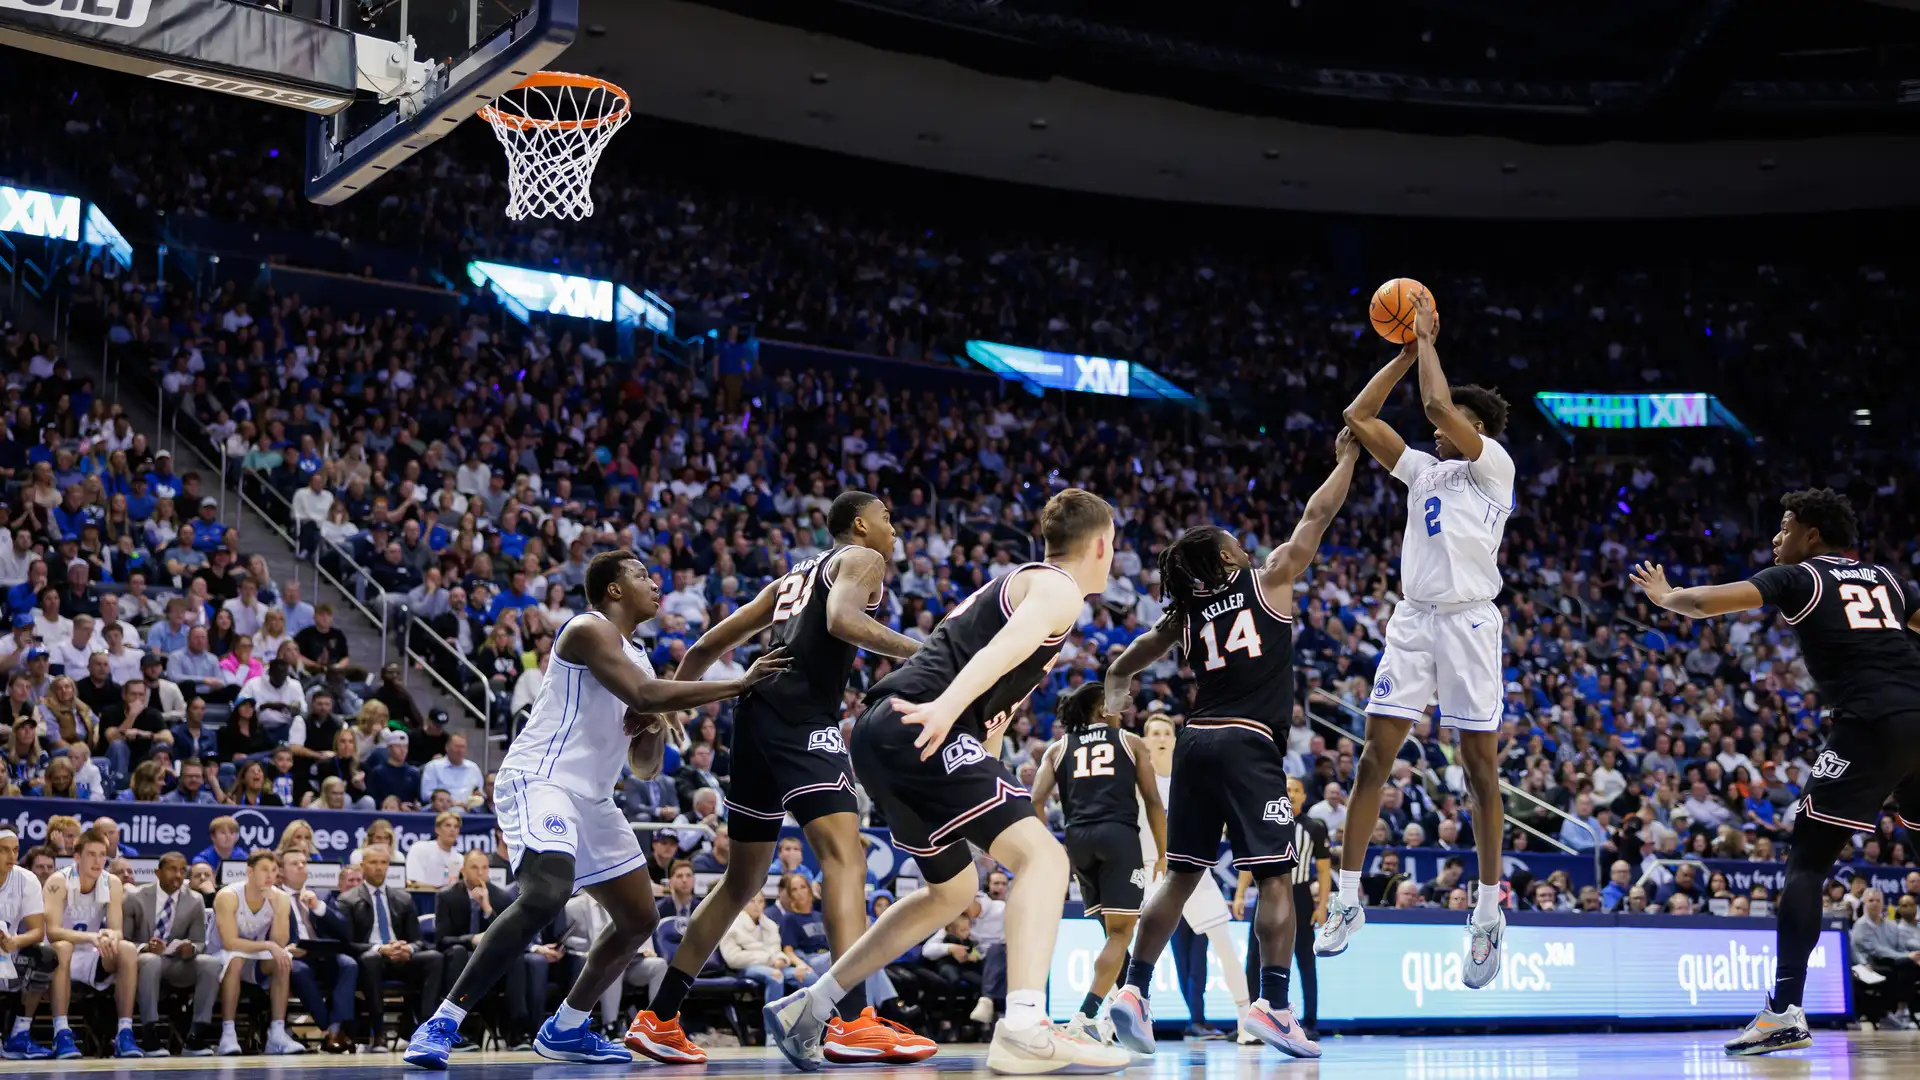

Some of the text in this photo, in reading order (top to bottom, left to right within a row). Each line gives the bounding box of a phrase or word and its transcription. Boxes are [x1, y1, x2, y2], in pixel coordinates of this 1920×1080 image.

[154, 73, 322, 105] BUILT
[0, 186, 80, 241] XM
[548, 273, 613, 322] XM
[1074, 355, 1129, 396] XM
[1650, 393, 1707, 427] XM
[1424, 496, 1441, 537] 2
[773, 574, 818, 620] 23
[1201, 593, 1244, 621] KELLER
[1839, 584, 1902, 630] 21
[1200, 608, 1262, 671] 14
[942, 733, 993, 774] OS
[1079, 730, 1107, 745] SMALL
[1073, 743, 1115, 778] 12
[16, 811, 48, 841] fo
